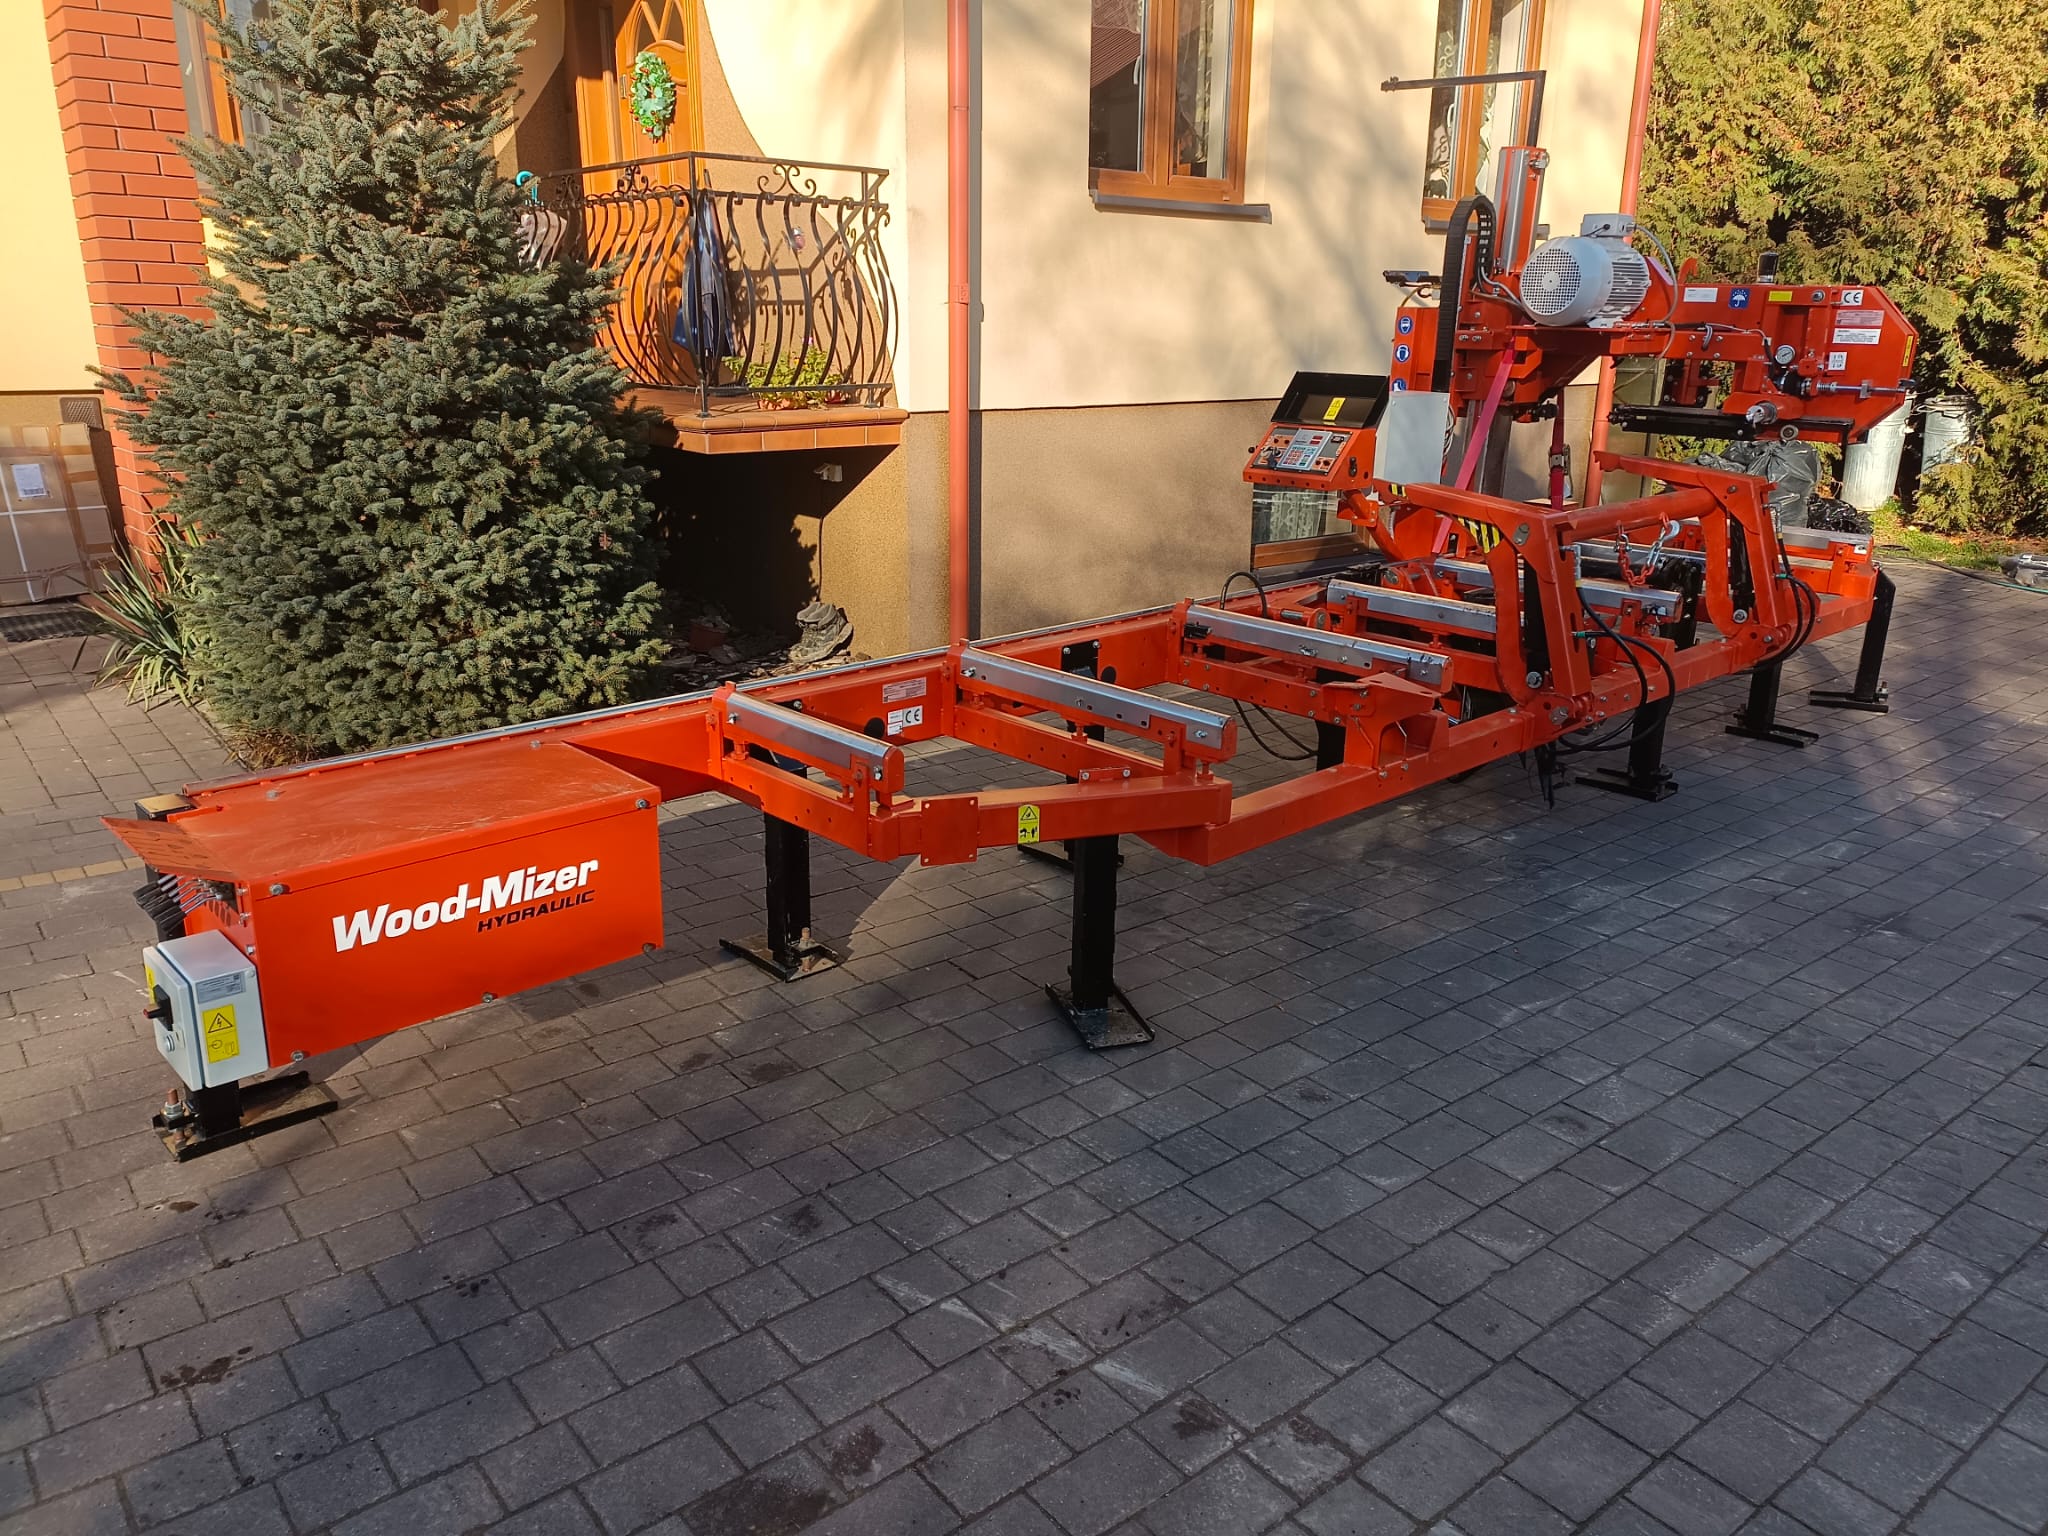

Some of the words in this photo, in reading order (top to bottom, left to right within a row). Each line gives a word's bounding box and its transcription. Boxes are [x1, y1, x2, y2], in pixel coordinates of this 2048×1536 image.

[1843, 291, 1861, 304] CE
[905, 708, 920, 723] CE
[332, 859, 599, 953] Wood-Mizer
[477, 889, 595, 933] HYDRAULIC
